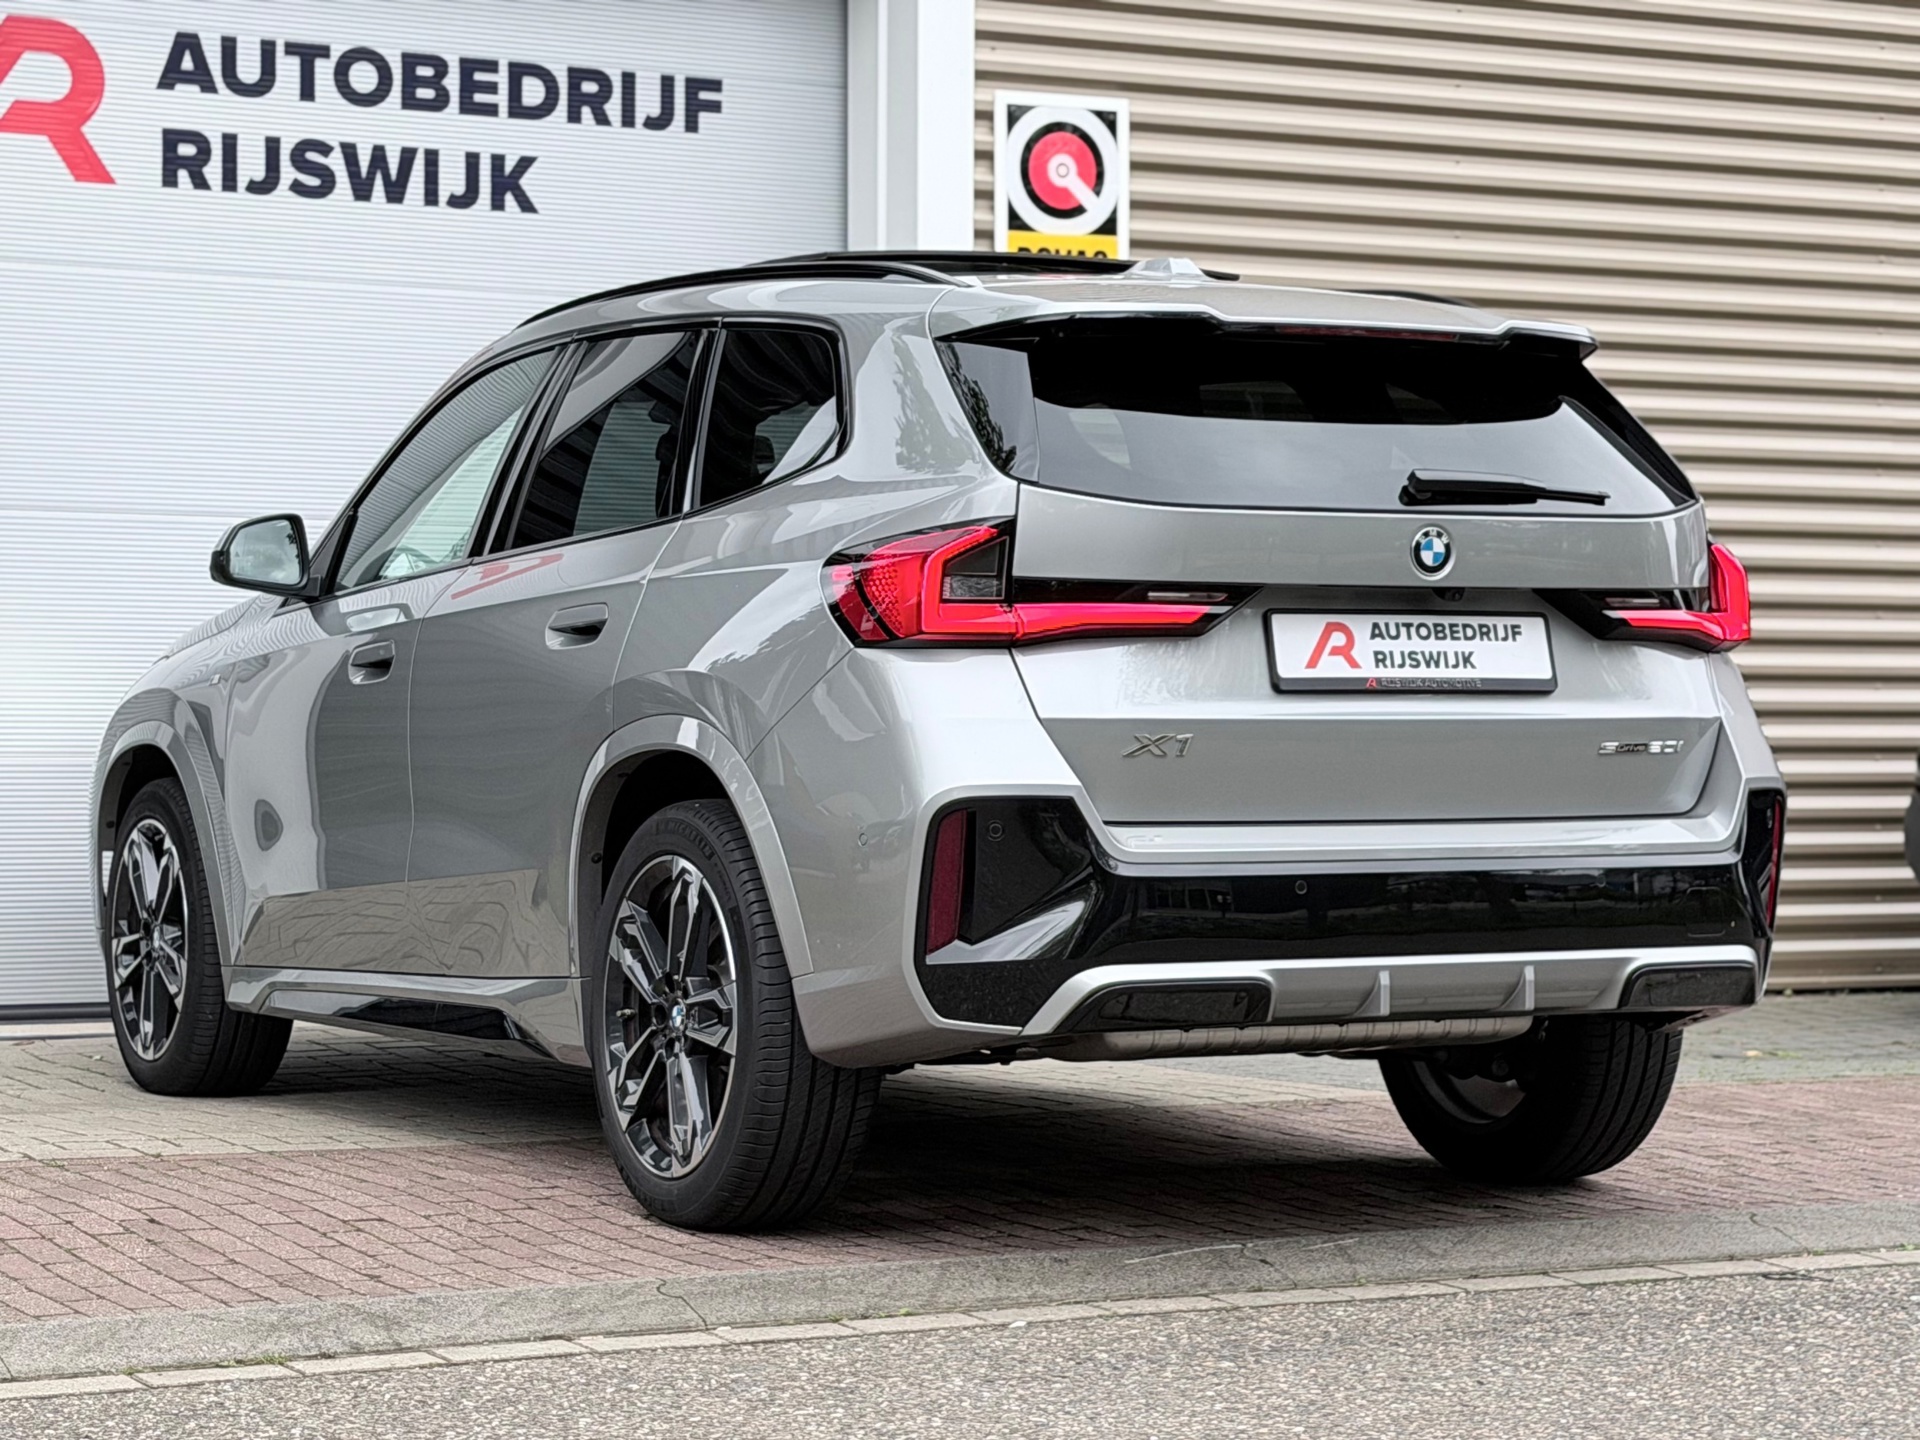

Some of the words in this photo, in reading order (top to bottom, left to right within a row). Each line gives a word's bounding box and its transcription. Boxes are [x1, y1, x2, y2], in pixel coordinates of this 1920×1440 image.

[156, 32, 723, 133] AUTOBEDRIJF
[162, 128, 539, 213] RIJSWIJK
[1369, 622, 1522, 642] AUTOBEDRIJF
[1373, 650, 1477, 669] RIJSWIJK
[1122, 733, 1194, 757] X1
